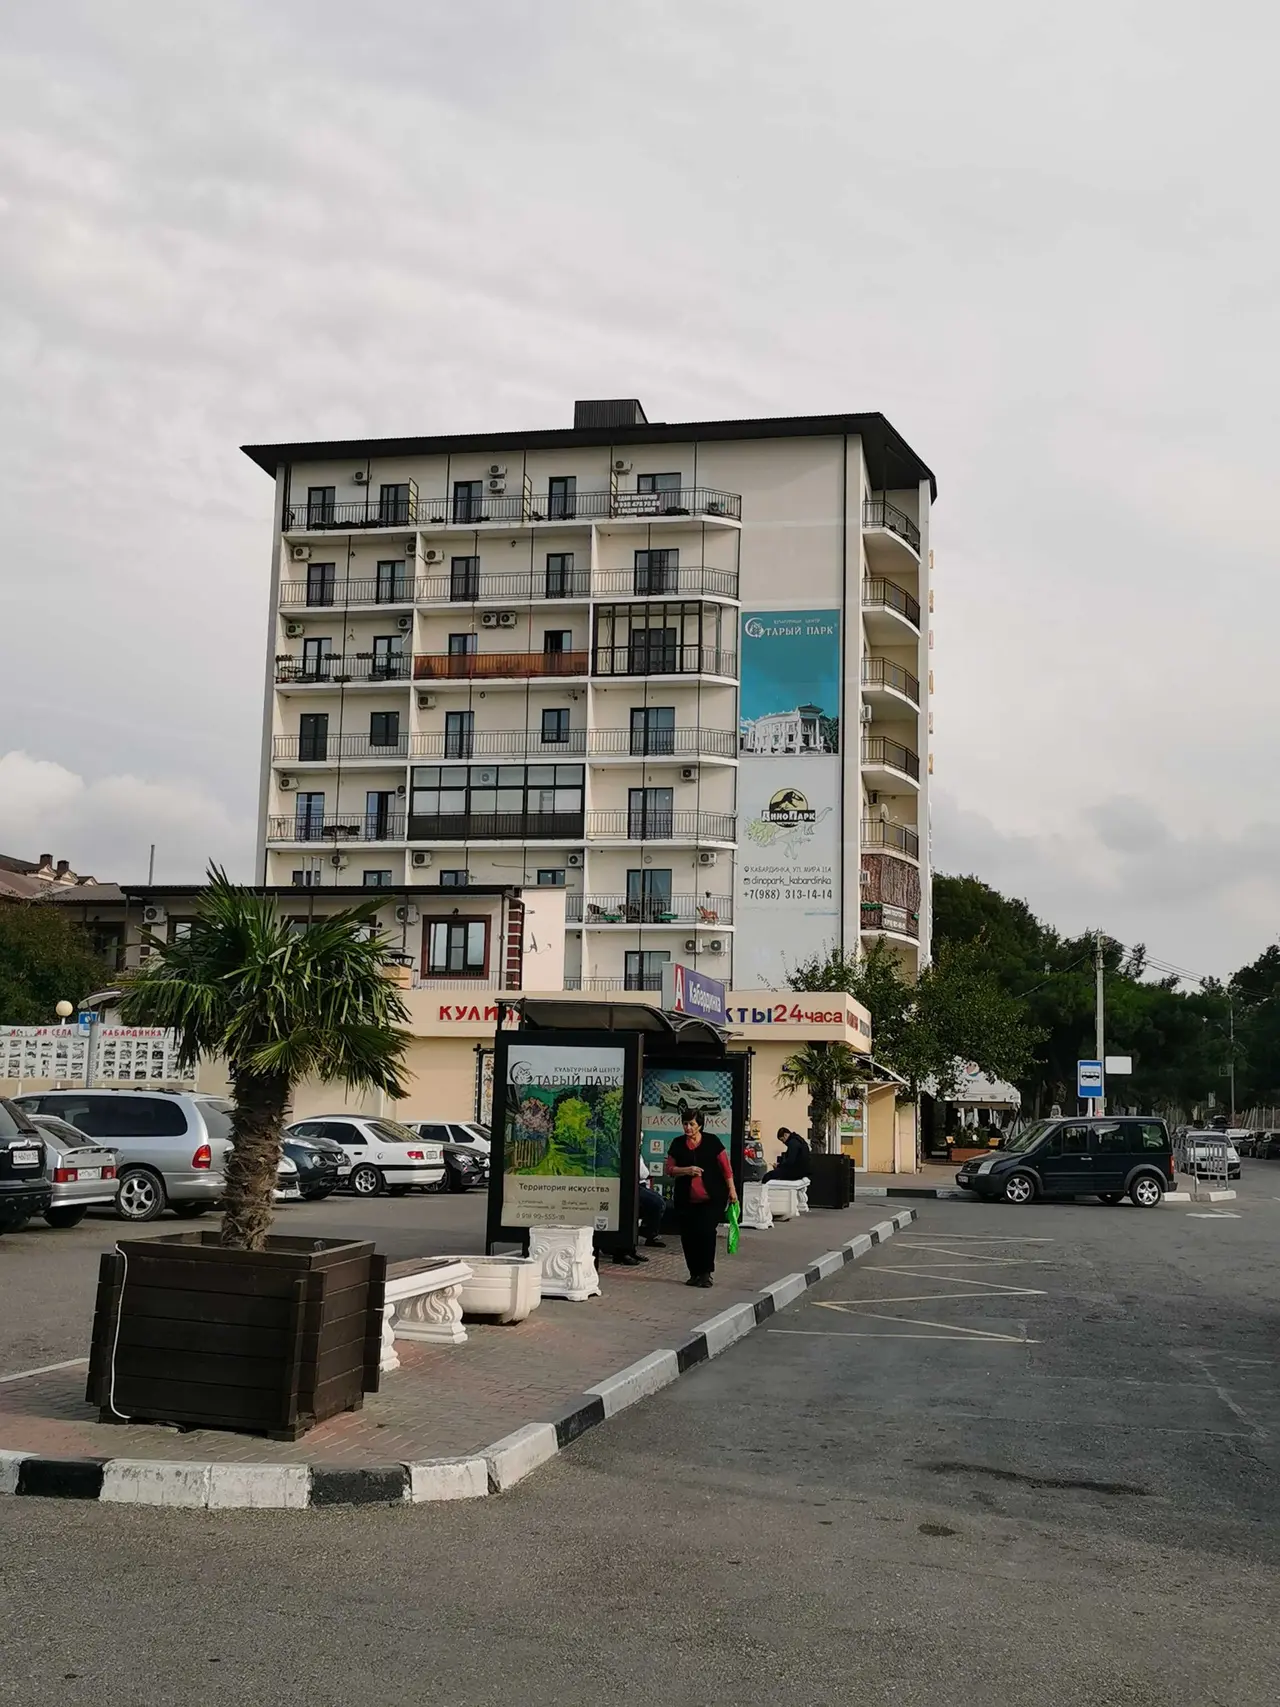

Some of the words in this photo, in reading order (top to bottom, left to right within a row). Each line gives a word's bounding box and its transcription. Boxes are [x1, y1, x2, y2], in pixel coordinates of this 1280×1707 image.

[806, 626, 834, 635] ПАРК
[743, 888, 780, 900] +7(988)
[785, 888, 833, 900] 313-14-14
[52, 1028, 72, 1036] СЕЛА
[585, 1075, 620, 1086] ПАРК
[519, 1183, 567, 1193] Территория
[568, 1185, 611, 1193] искусства
